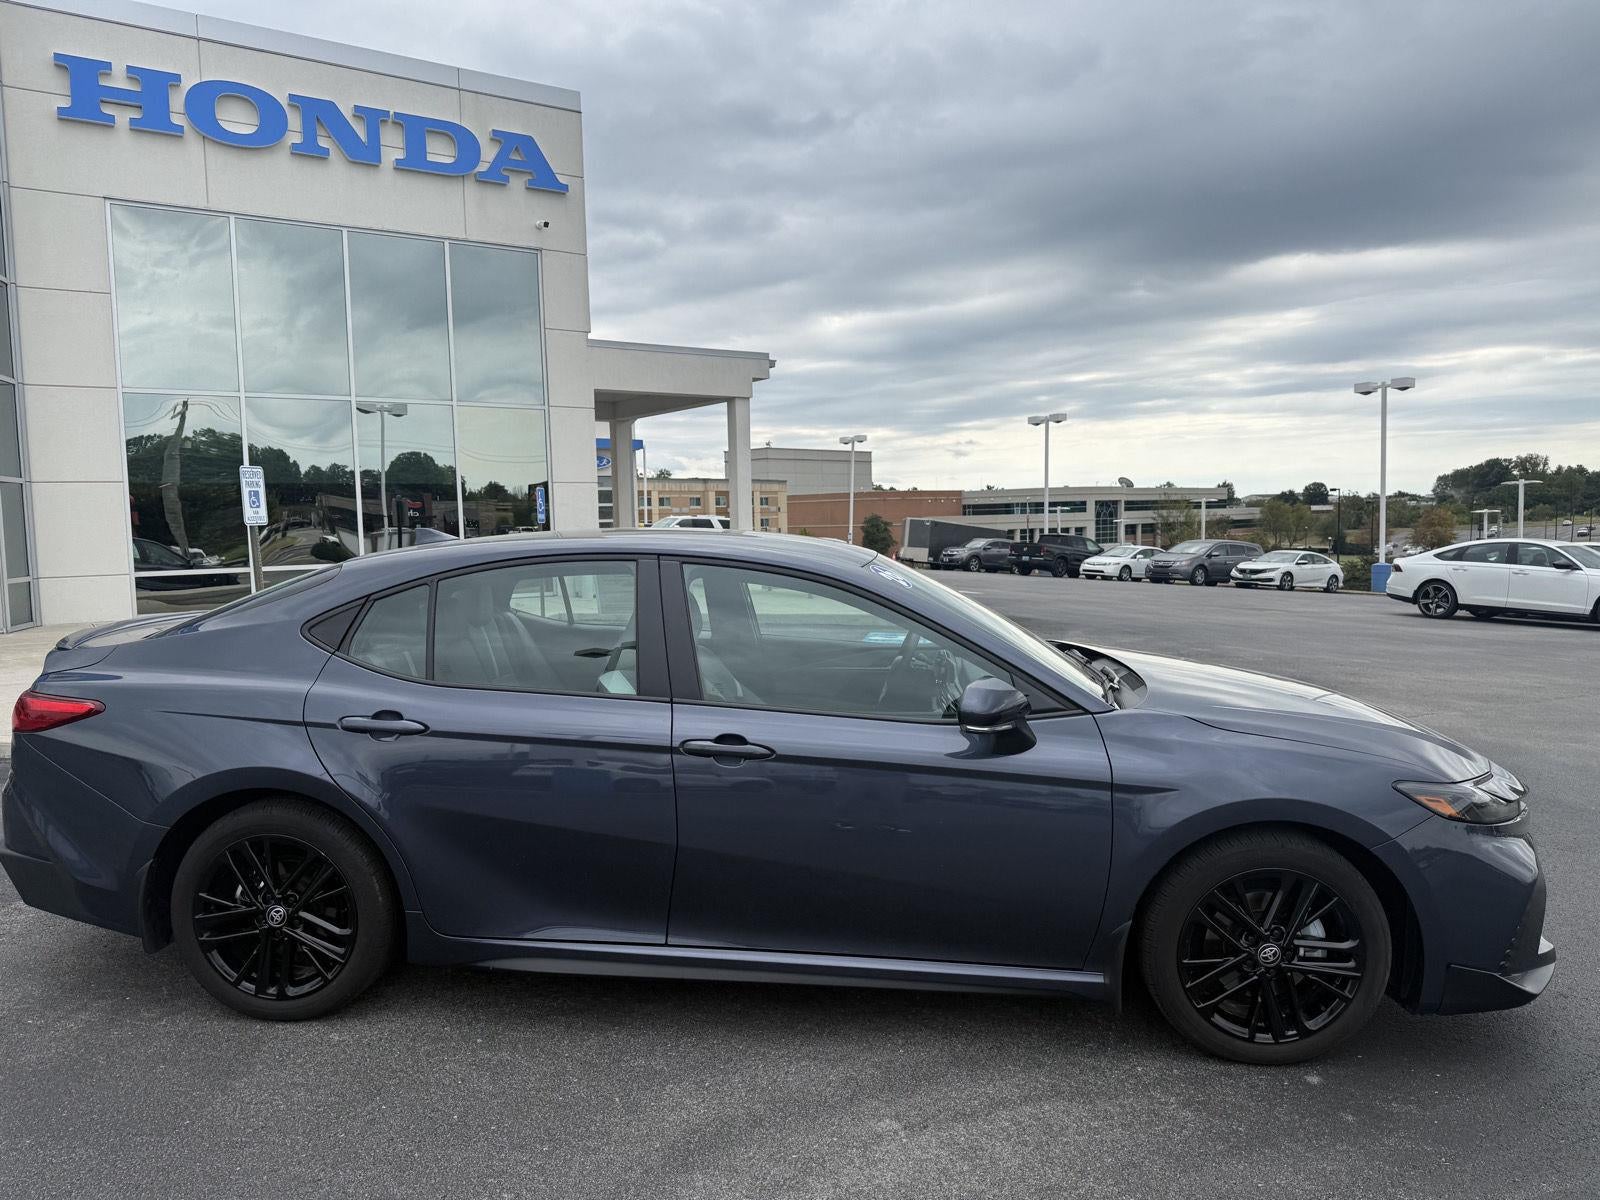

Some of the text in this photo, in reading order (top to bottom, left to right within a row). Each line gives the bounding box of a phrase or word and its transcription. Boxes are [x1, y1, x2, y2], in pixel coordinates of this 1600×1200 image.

[53, 52, 569, 193] HONDA
[242, 470, 262, 479] RESERVED
[245, 480, 261, 489] PARKING
